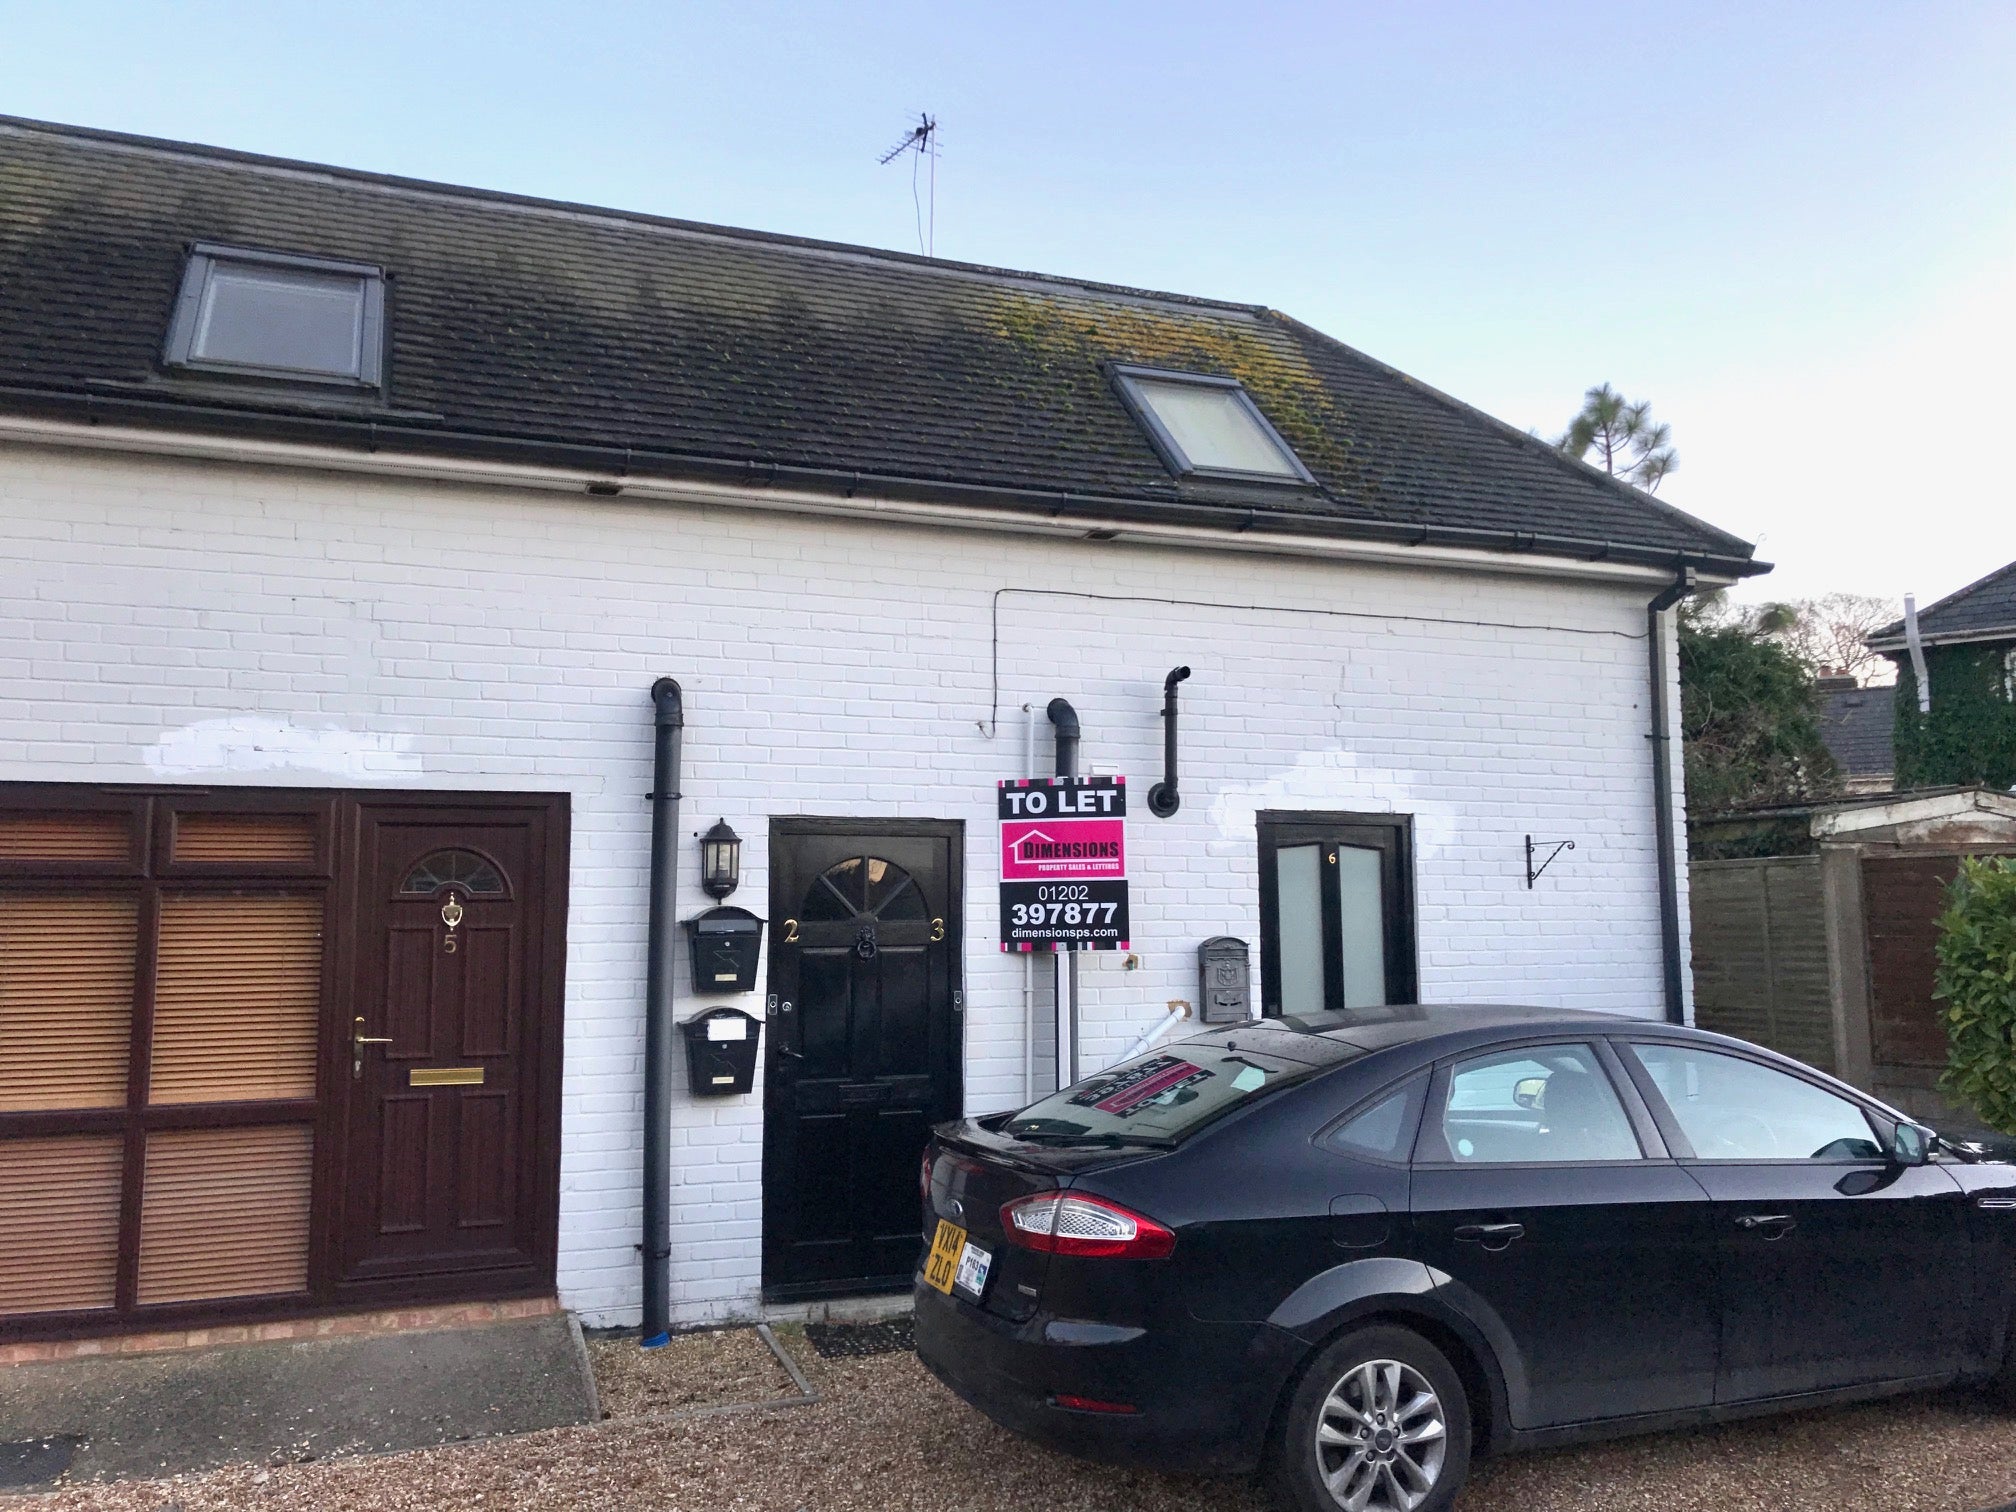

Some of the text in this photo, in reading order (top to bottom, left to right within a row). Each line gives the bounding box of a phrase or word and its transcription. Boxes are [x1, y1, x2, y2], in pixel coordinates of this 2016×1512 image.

[1006, 790, 1117, 814] TO LET
[1024, 842, 1118, 858] DIMENSIONS
[1328, 853, 1336, 864] 6
[1068, 863, 1086, 871] SALES
[1092, 863, 1119, 871] LETTINGS
[1038, 885, 1089, 901] 01202
[1011, 902, 1118, 925] 397877
[783, 918, 799, 943] 2
[930, 917, 945, 942] 3
[1011, 927, 1118, 939] dimensionsps.com
[444, 934, 457, 954] 5
